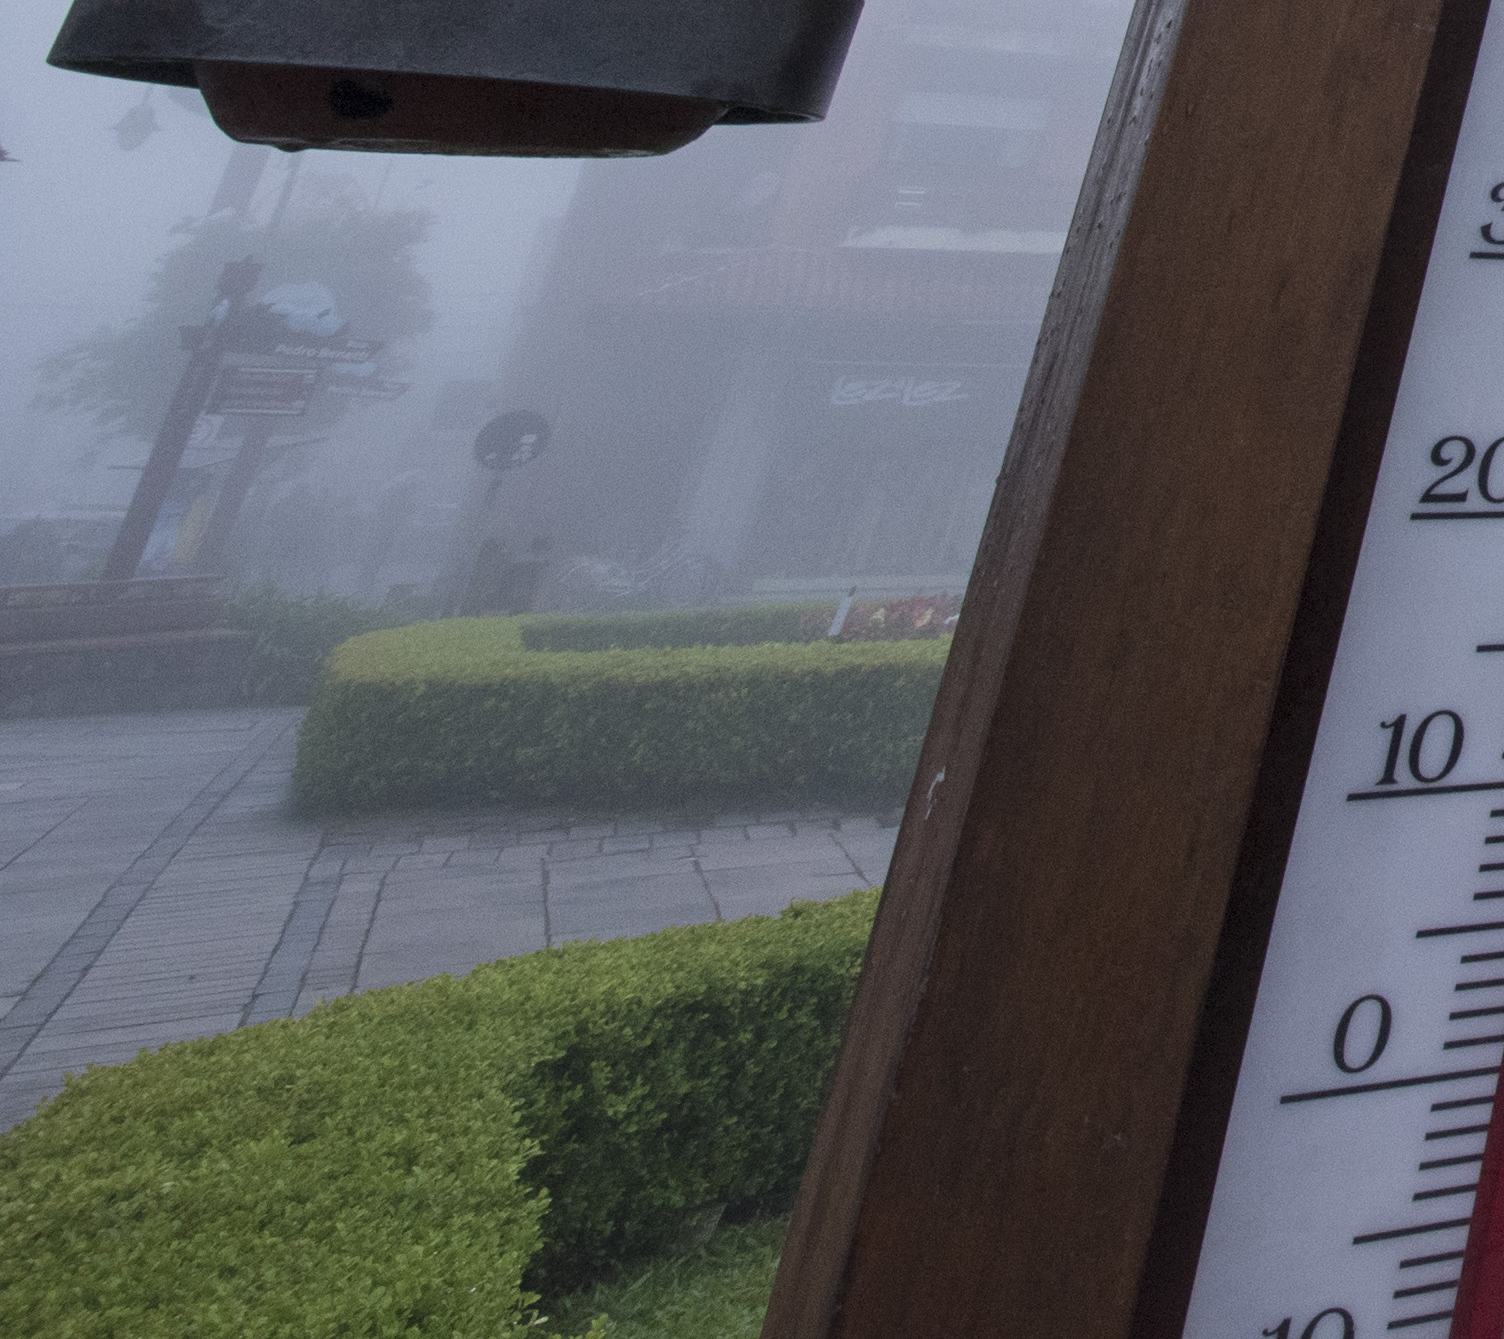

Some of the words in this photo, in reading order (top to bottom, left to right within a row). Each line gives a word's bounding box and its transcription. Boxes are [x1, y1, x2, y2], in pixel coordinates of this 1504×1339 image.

[275, 344, 316, 357] Pedro
[1374, 709, 1464, 786] 10
[1333, 993, 1392, 1073] 0
